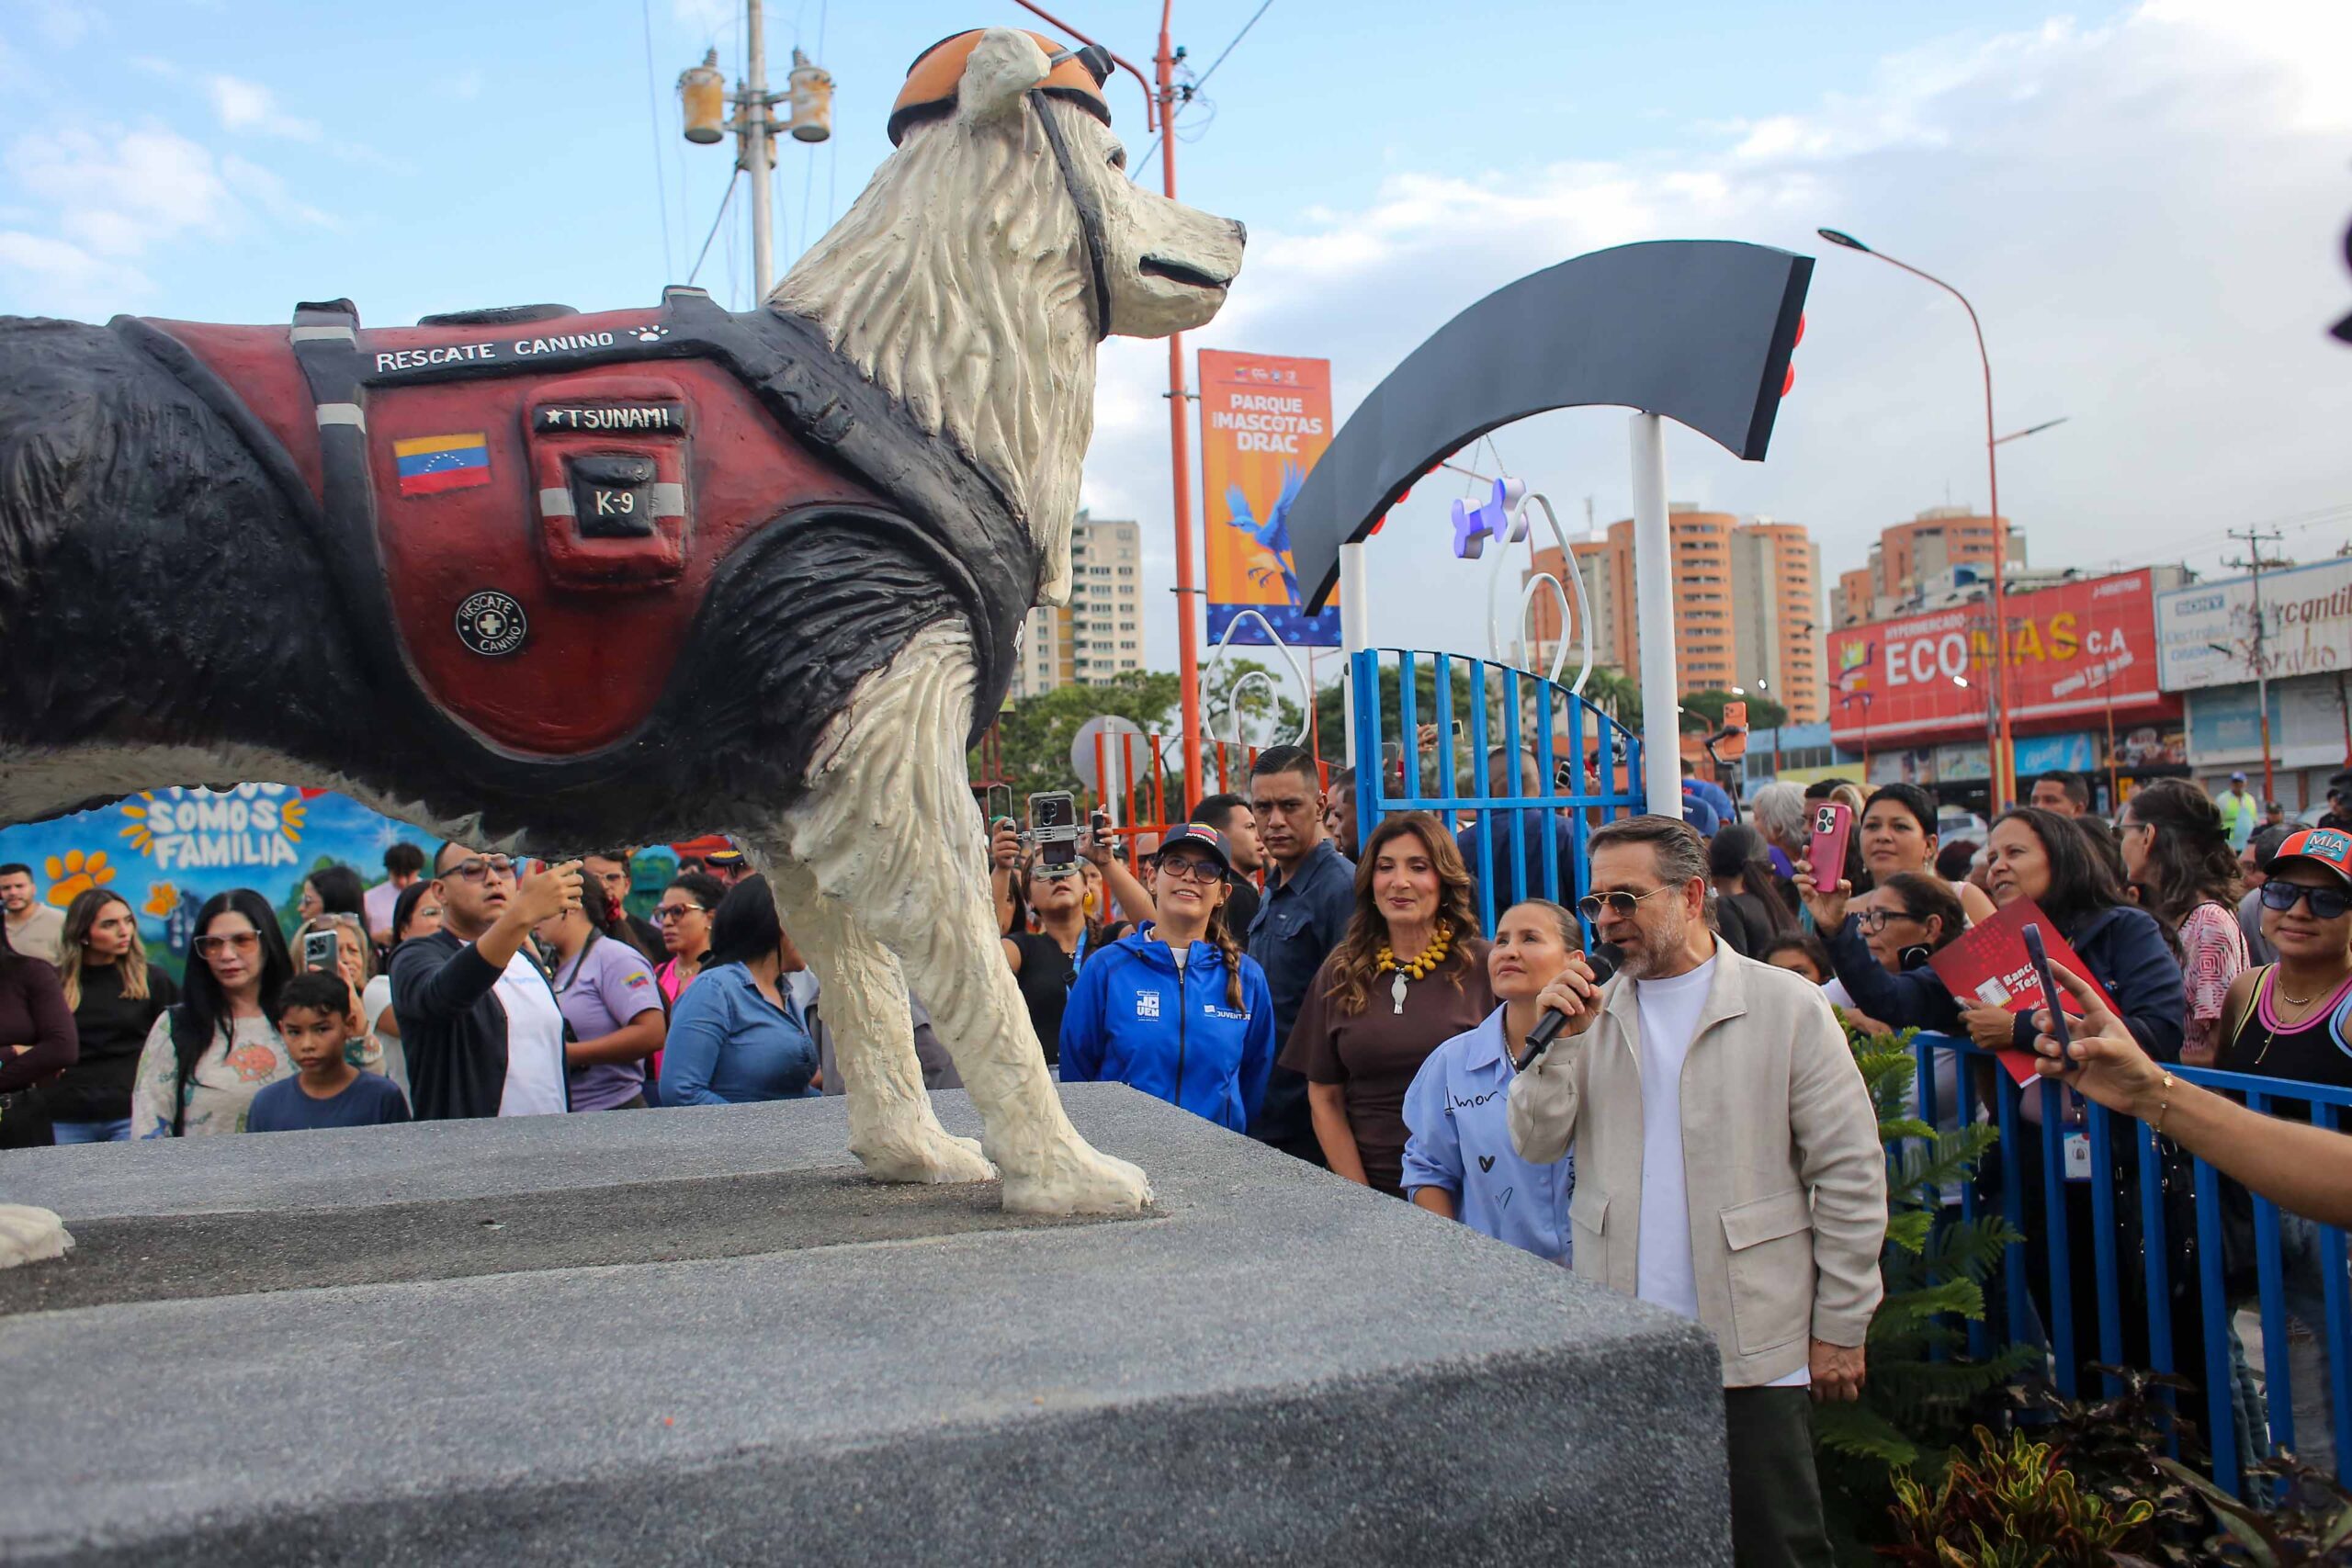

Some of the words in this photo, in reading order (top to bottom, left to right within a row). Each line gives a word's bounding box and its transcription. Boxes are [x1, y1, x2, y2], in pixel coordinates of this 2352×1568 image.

[376, 344, 496, 373] RESCATE
[514, 332, 614, 356] CANINO
[1231, 394, 1303, 414] PARQUE
[565, 407, 669, 429] TSUNAMI
[1218, 412, 1323, 436] MASCOTAS
[1237, 431, 1299, 454] DRAC
[595, 490, 636, 515] K-9
[460, 595, 514, 621] RESCATE
[480, 626, 522, 652] CANINO
[147, 799, 278, 834] SOMOS
[154, 831, 299, 870] FAMILIA
[2016, 974, 2038, 992] Tes
